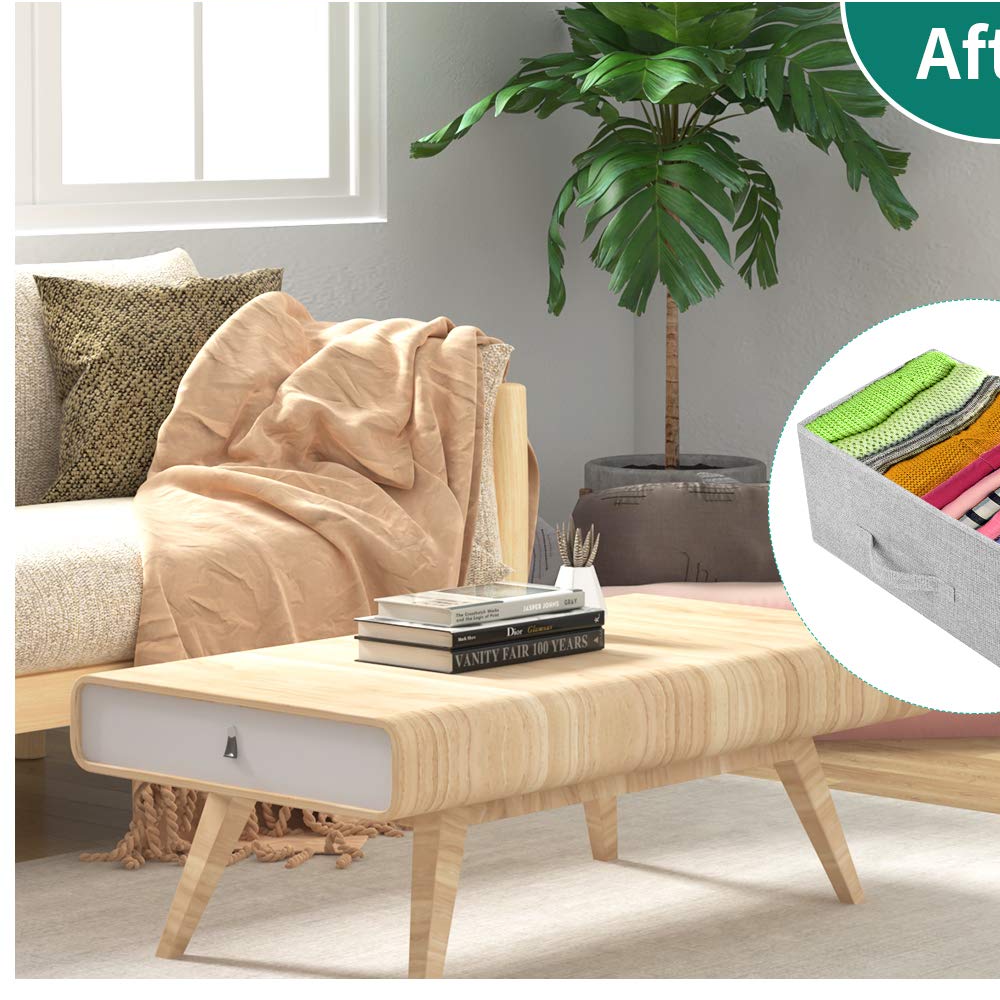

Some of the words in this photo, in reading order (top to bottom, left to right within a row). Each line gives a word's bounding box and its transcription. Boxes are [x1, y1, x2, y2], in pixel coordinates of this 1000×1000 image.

[523, 602, 542, 612] JASPER
[542, 601, 560, 609] JOHNS
[564, 598, 578, 606] GRAY
[506, 627, 523, 637] Dior
[455, 648, 501, 668] VANITY
[502, 644, 529, 661] FAIR
[533, 640, 549, 656] 100
[551, 634, 589, 653] YEARS
